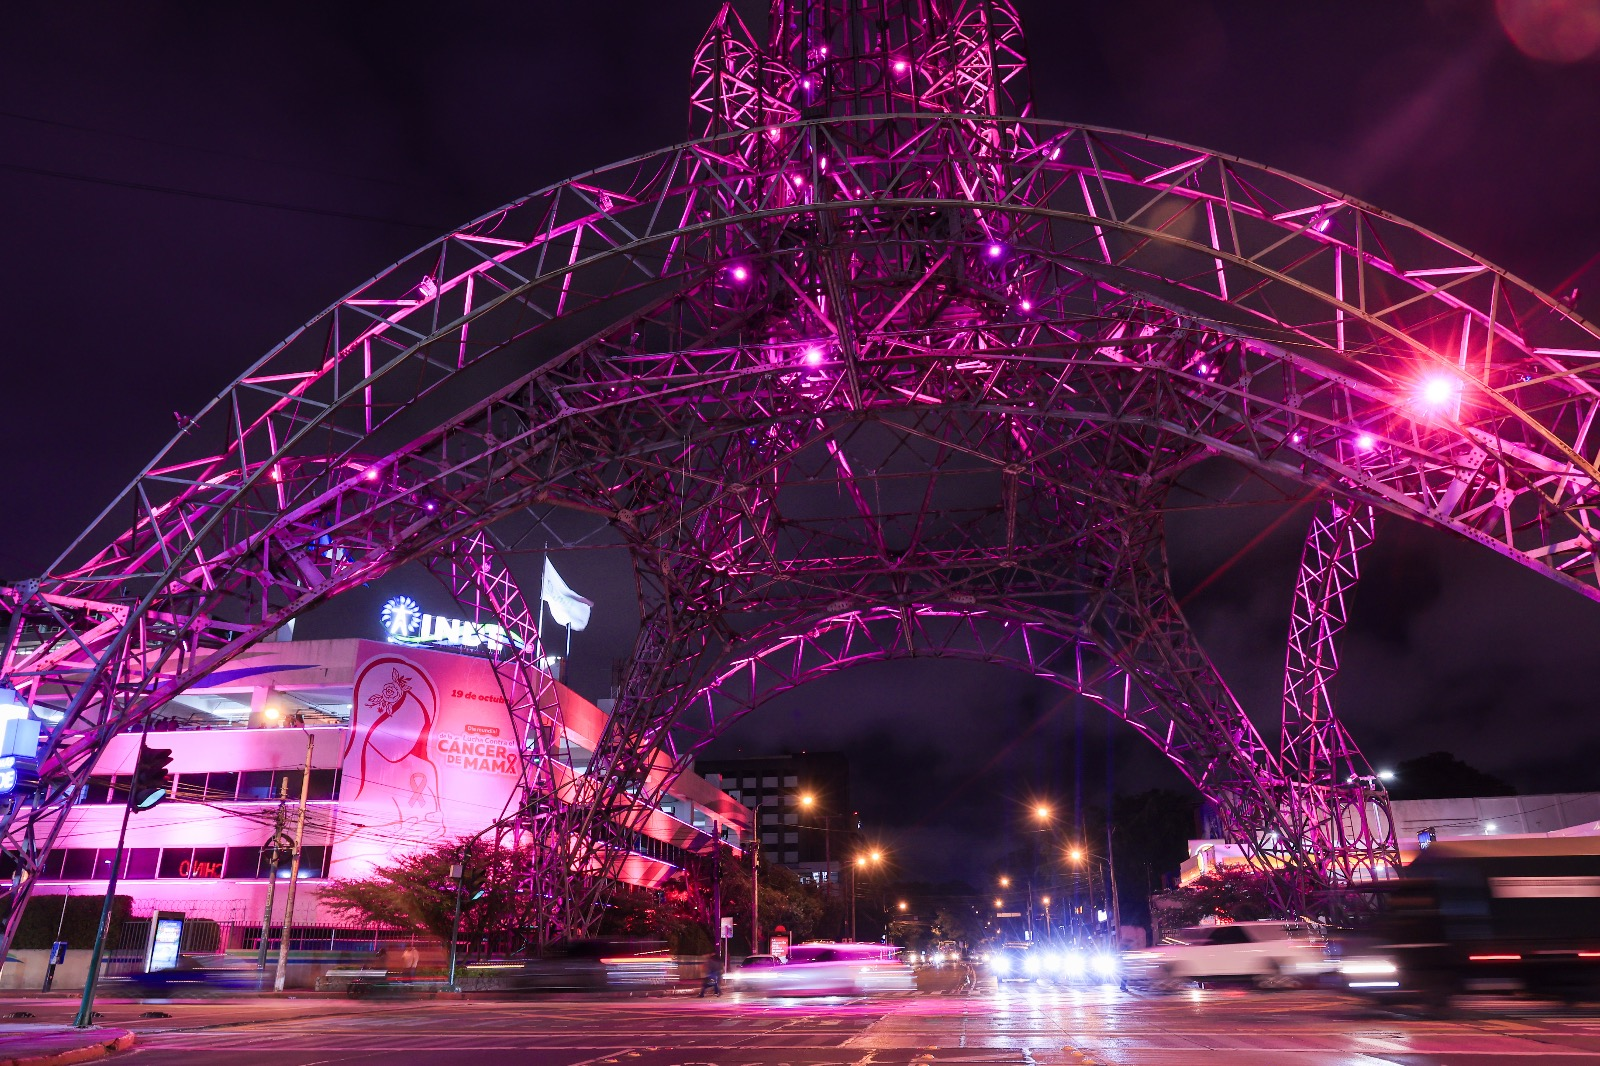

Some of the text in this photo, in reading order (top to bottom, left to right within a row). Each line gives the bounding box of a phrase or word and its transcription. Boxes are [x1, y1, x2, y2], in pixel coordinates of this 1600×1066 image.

[451, 689, 514, 705] 19 de octub
[485, 737, 508, 746] Contra
[447, 754, 462, 764] DE
